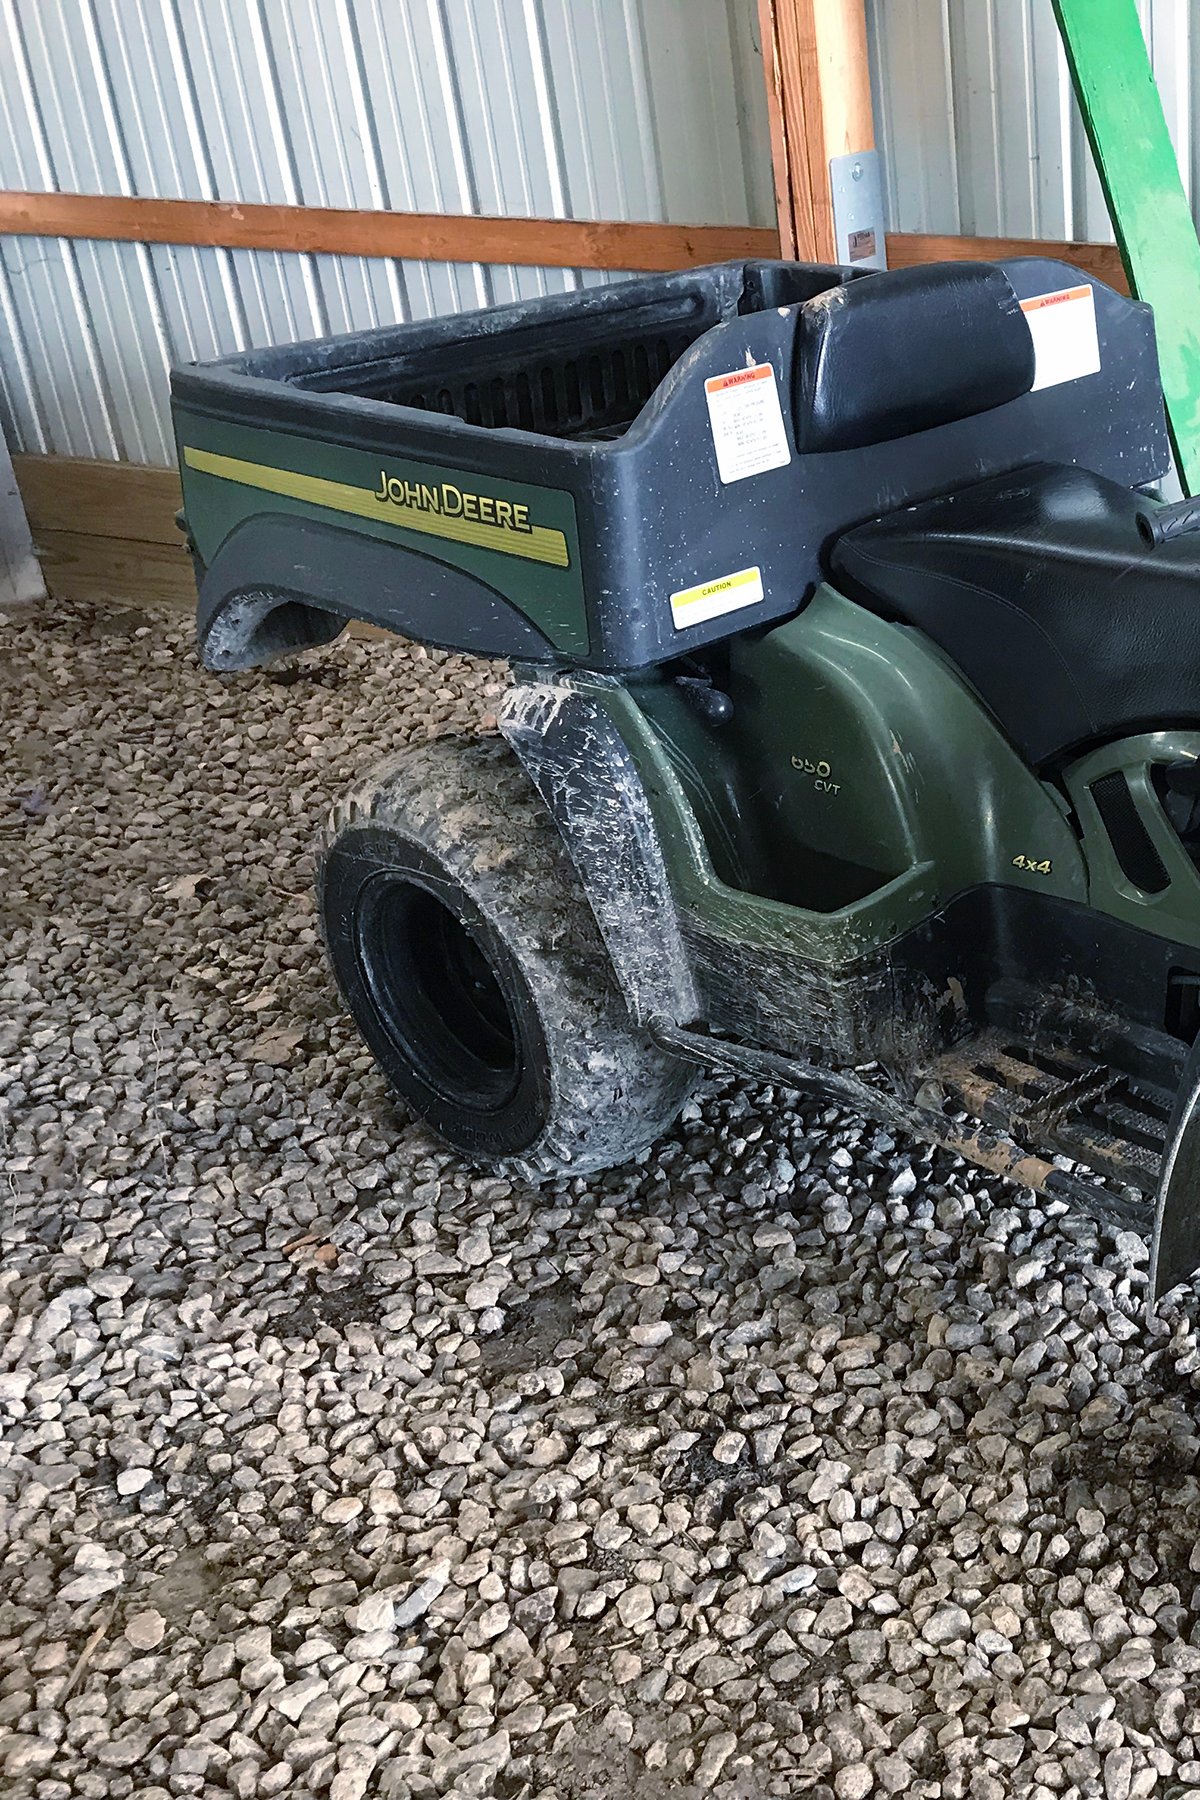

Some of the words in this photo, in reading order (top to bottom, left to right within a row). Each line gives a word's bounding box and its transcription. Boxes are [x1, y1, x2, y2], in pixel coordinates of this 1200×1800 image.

[728, 373, 756, 386] WARNING
[375, 470, 441, 513] JOHN
[441, 483, 532, 534] DEERE
[702, 581, 732, 596] CAUTION
[814, 779, 841, 796] CVT
[1012, 855, 1051, 874] 4x4
